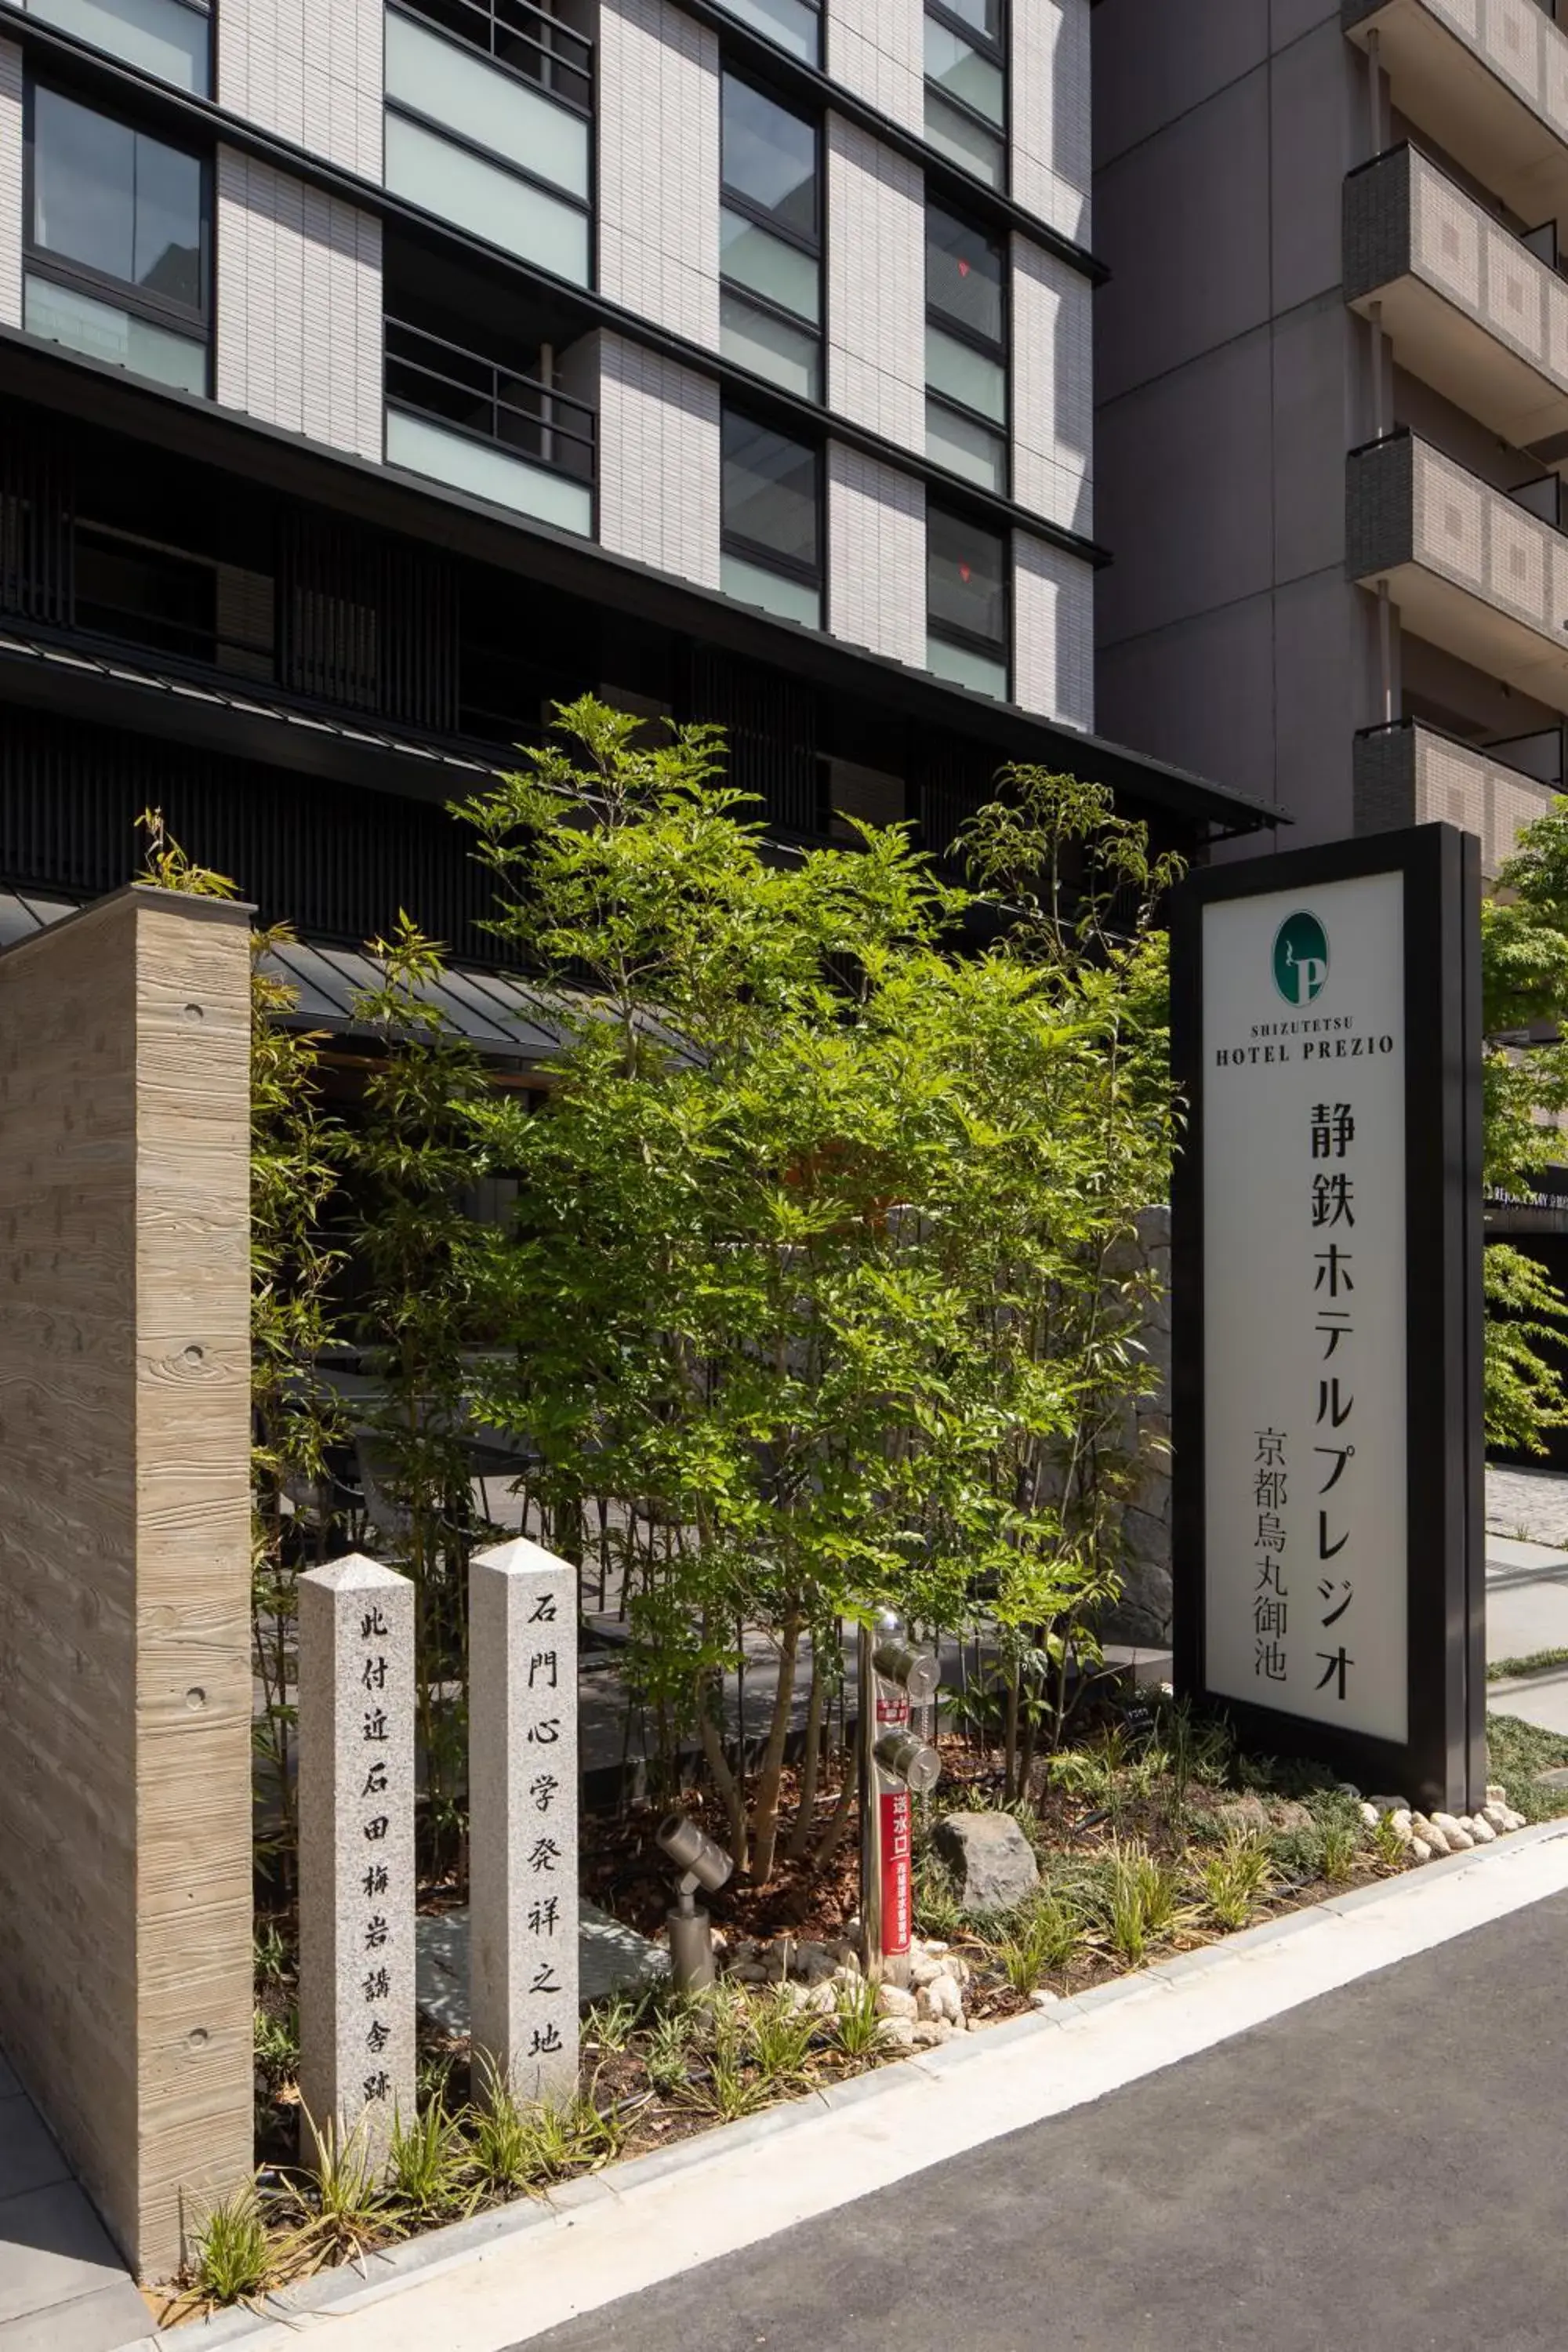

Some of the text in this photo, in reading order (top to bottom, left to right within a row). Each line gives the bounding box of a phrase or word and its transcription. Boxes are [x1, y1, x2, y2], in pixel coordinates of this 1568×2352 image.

[1216, 1034, 1394, 1067] HOTEL PREZIO
[1250, 1016, 1353, 1038] SHIZUTETSU
[1310, 1102, 1356, 1701] 静鉄ホテルプレジオ
[1253, 1427, 1288, 1682] 京都烏丸御池
[528, 1593, 563, 2058] 石門心学発祥之地
